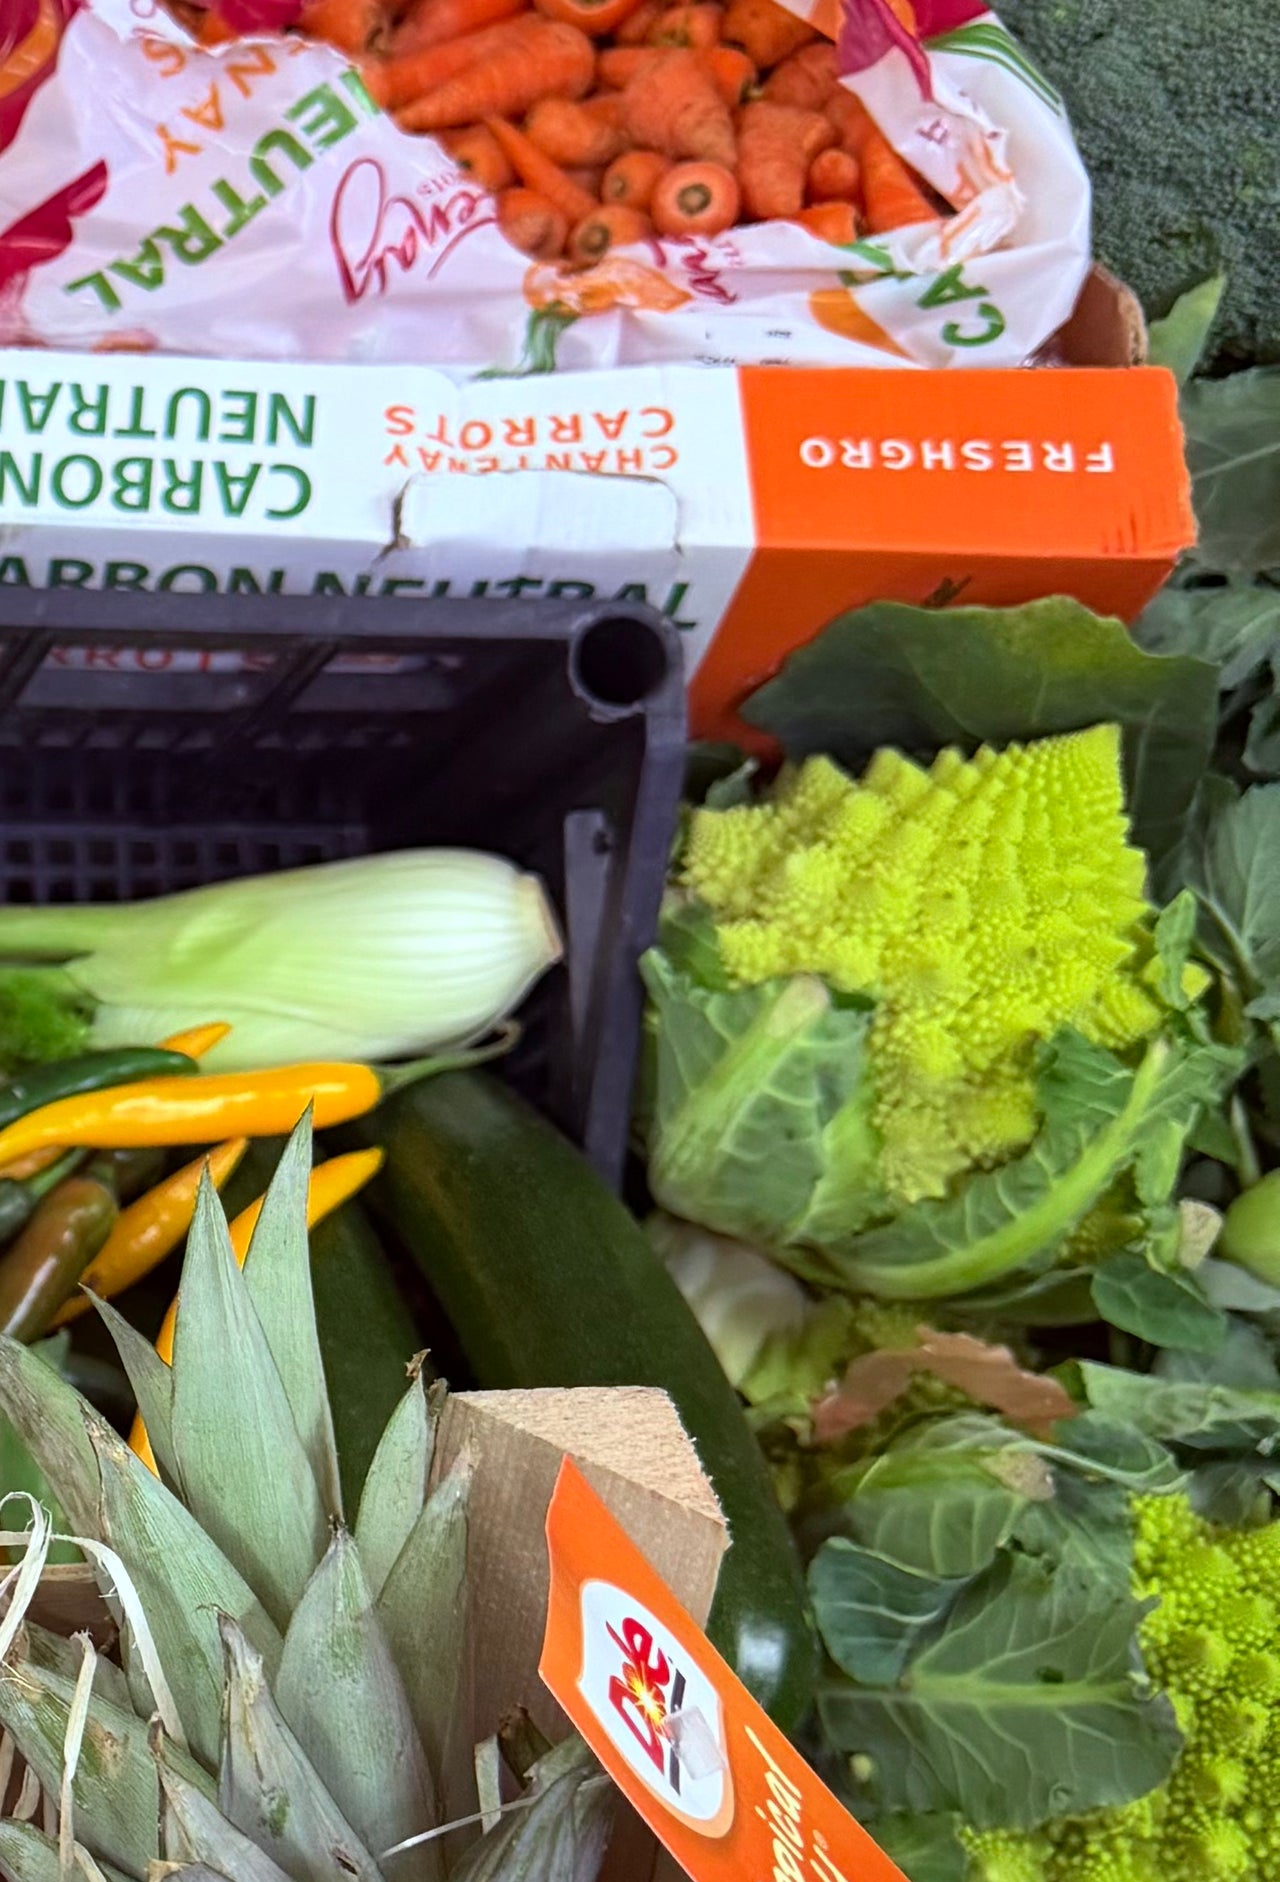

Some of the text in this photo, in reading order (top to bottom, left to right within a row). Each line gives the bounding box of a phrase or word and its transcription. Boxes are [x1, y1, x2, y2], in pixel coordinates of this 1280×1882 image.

[156, 40, 304, 175] NAY
[383, 404, 676, 452] CARROTS
[800, 435, 1116, 474] FRESHGRO
[605, 1616, 671, 1776] Dole
